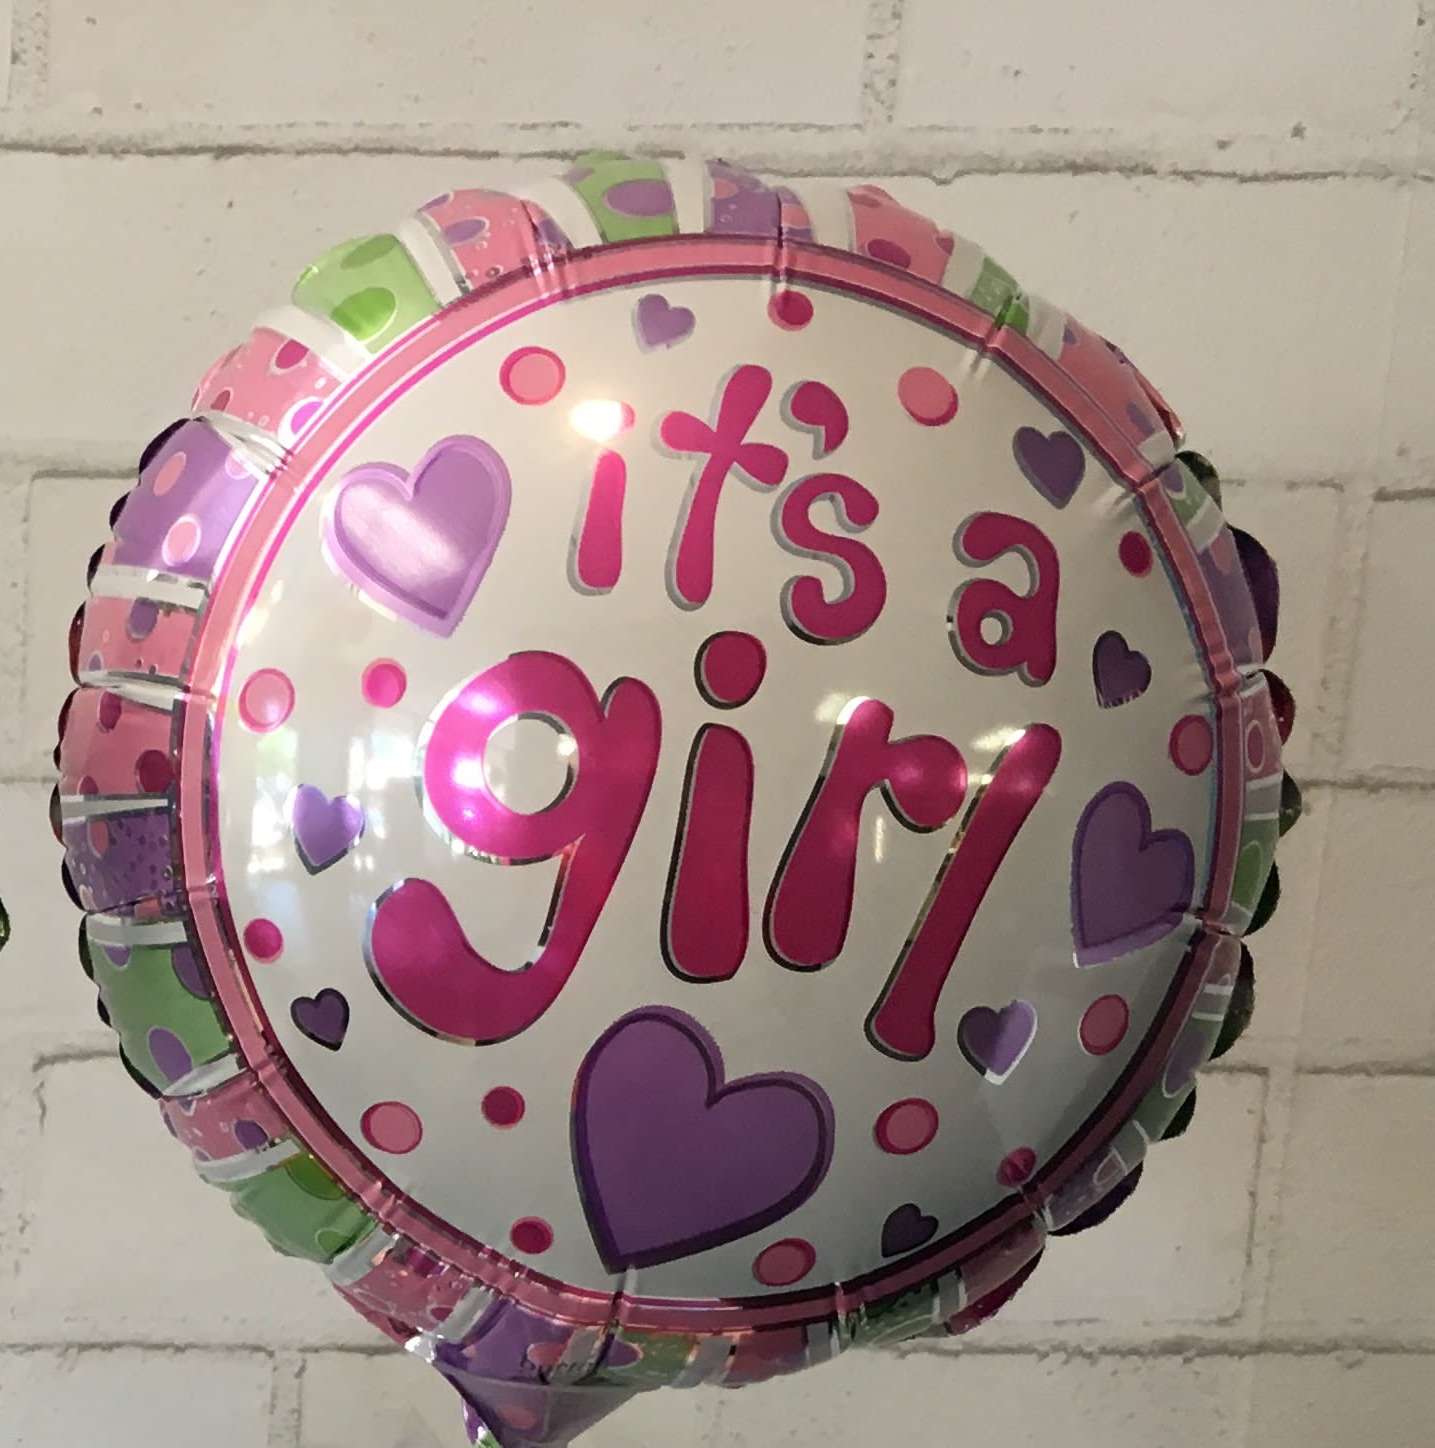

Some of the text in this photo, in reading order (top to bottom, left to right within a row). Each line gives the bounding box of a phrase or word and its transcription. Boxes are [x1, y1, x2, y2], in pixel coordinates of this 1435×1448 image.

[567, 364, 1061, 686] it's a
[366, 631, 1063, 1064] girl
